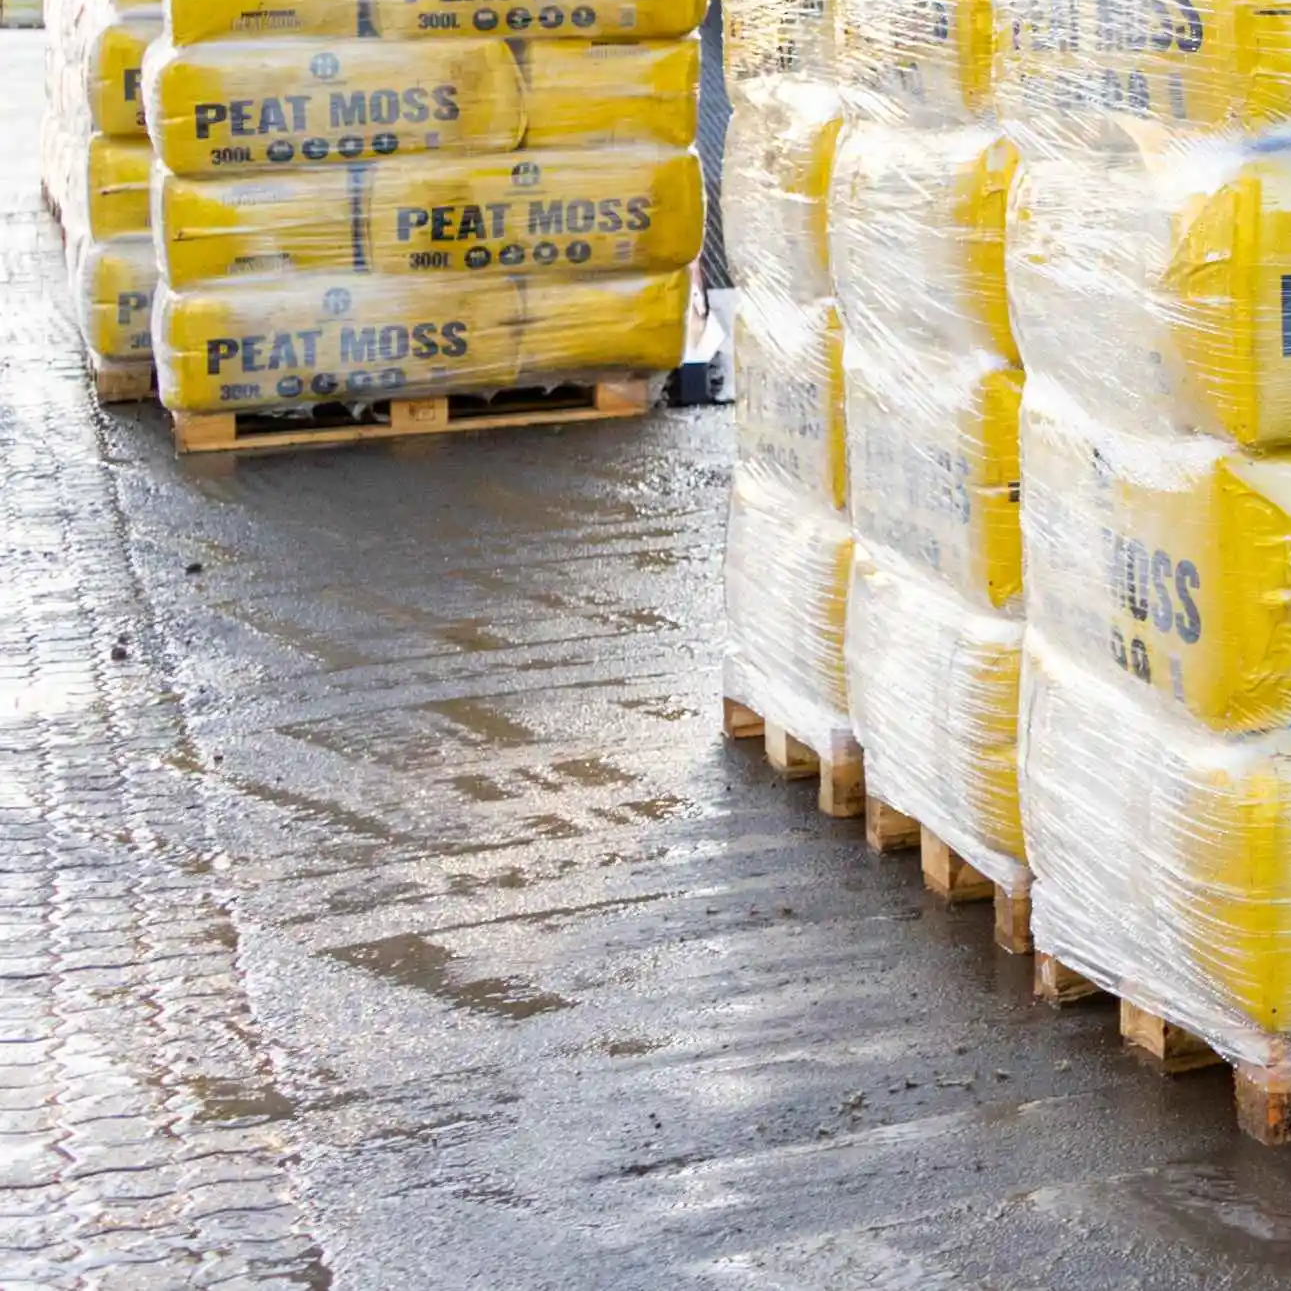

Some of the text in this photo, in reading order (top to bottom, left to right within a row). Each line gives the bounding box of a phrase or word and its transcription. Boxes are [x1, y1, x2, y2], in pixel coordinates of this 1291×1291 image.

[417, 12, 460, 30] 300L
[194, 84, 460, 140] PEAT MOSS
[210, 147, 256, 166] 300L
[397, 196, 651, 242] PEAT MOSS
[409, 251, 450, 271] 300L
[206, 321, 468, 375] PEAT MOSS
